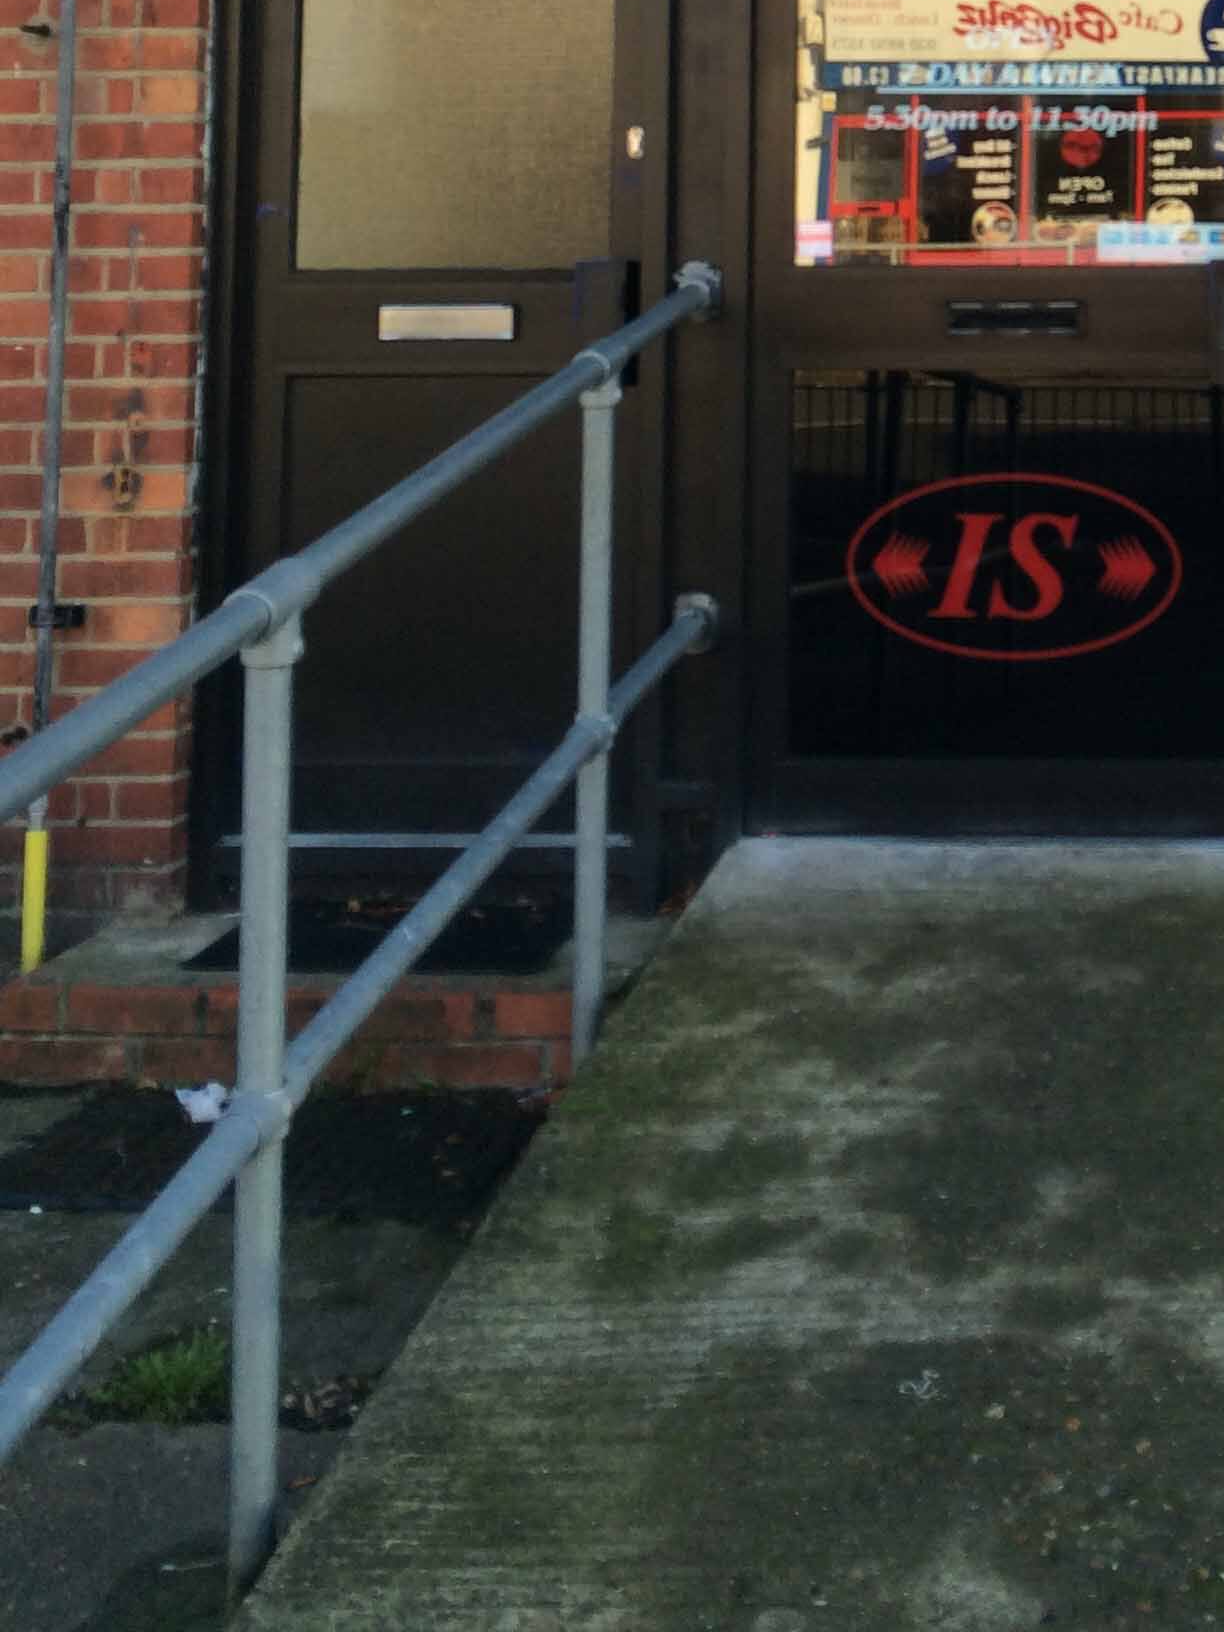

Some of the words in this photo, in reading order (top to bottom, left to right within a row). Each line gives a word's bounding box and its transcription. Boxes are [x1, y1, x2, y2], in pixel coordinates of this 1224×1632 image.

[864, 104, 978, 135] 5.30pm
[985, 104, 1018, 131] to
[1028, 104, 1159, 138] 11.30pm
[928, 512, 1080, 622] IS
